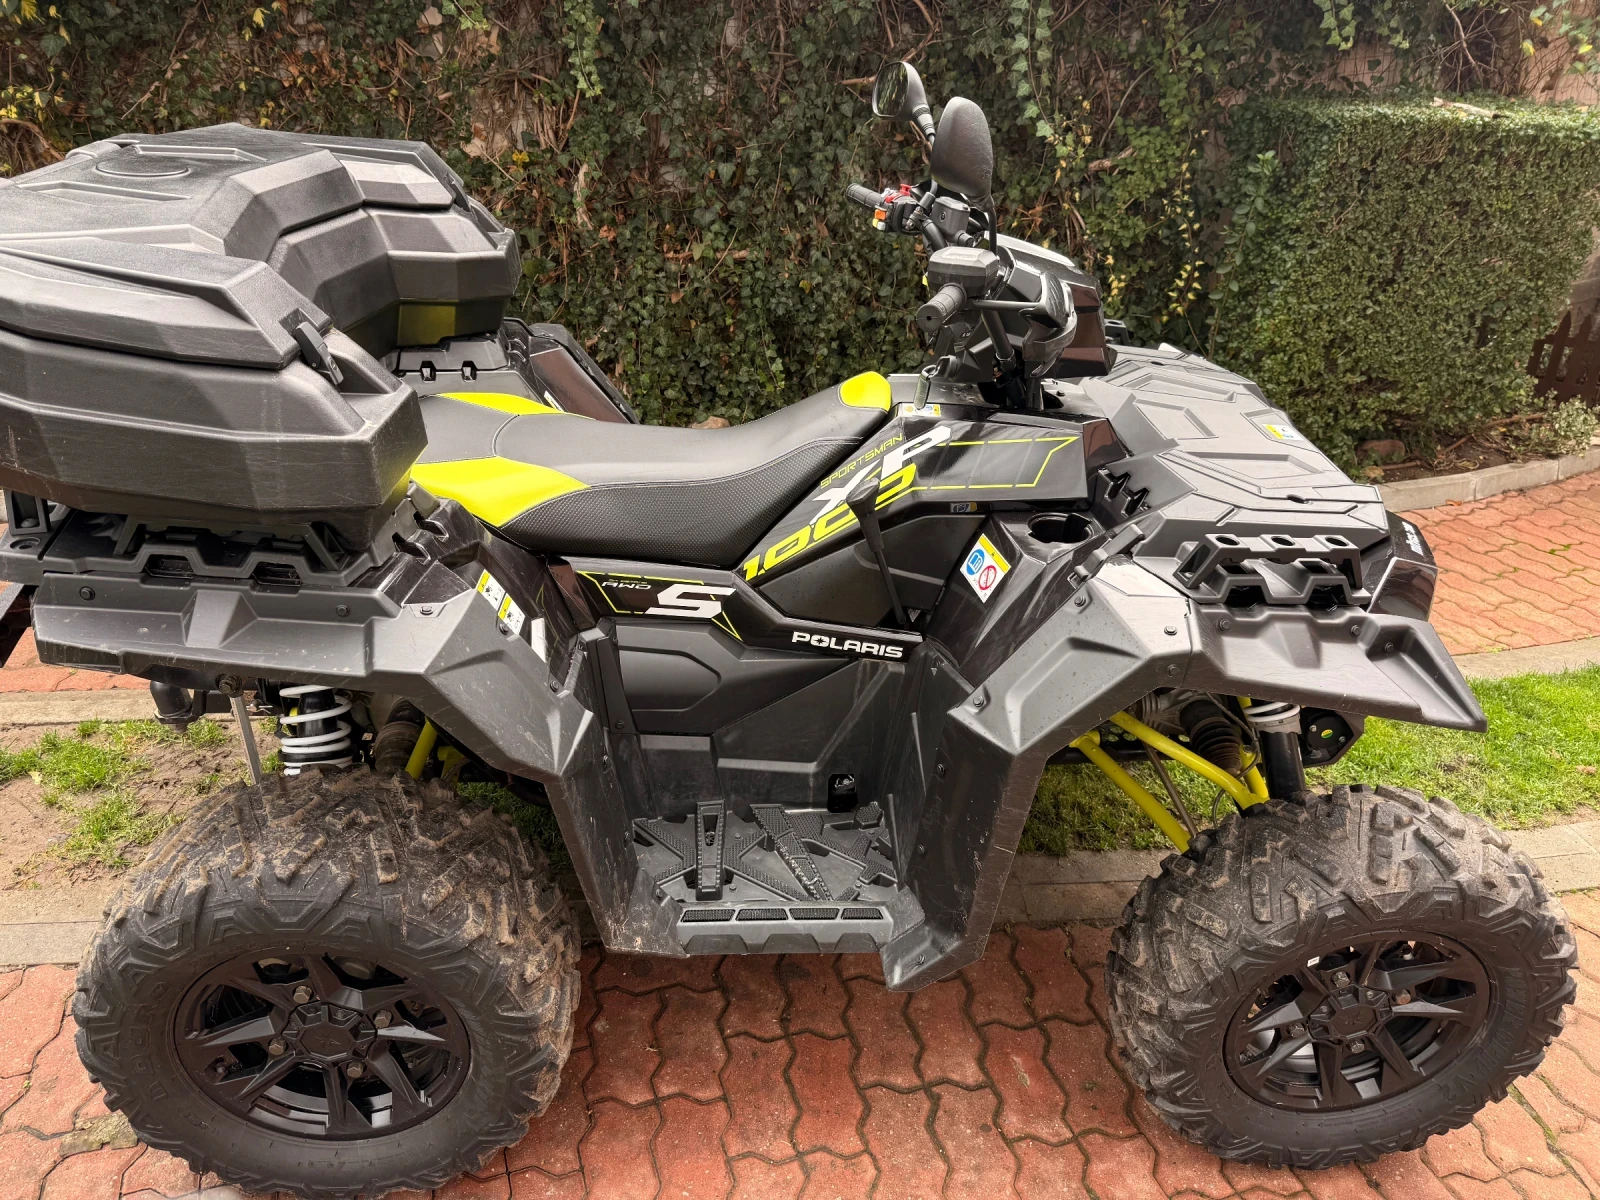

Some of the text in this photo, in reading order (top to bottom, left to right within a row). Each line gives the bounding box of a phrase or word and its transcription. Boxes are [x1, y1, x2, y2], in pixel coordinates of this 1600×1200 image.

[811, 425, 951, 525] XP
[820, 433, 903, 489] SPORTSMAN
[601, 581, 652, 590] AWD
[644, 583, 737, 619] S
[791, 631, 904, 658] POLARIS
